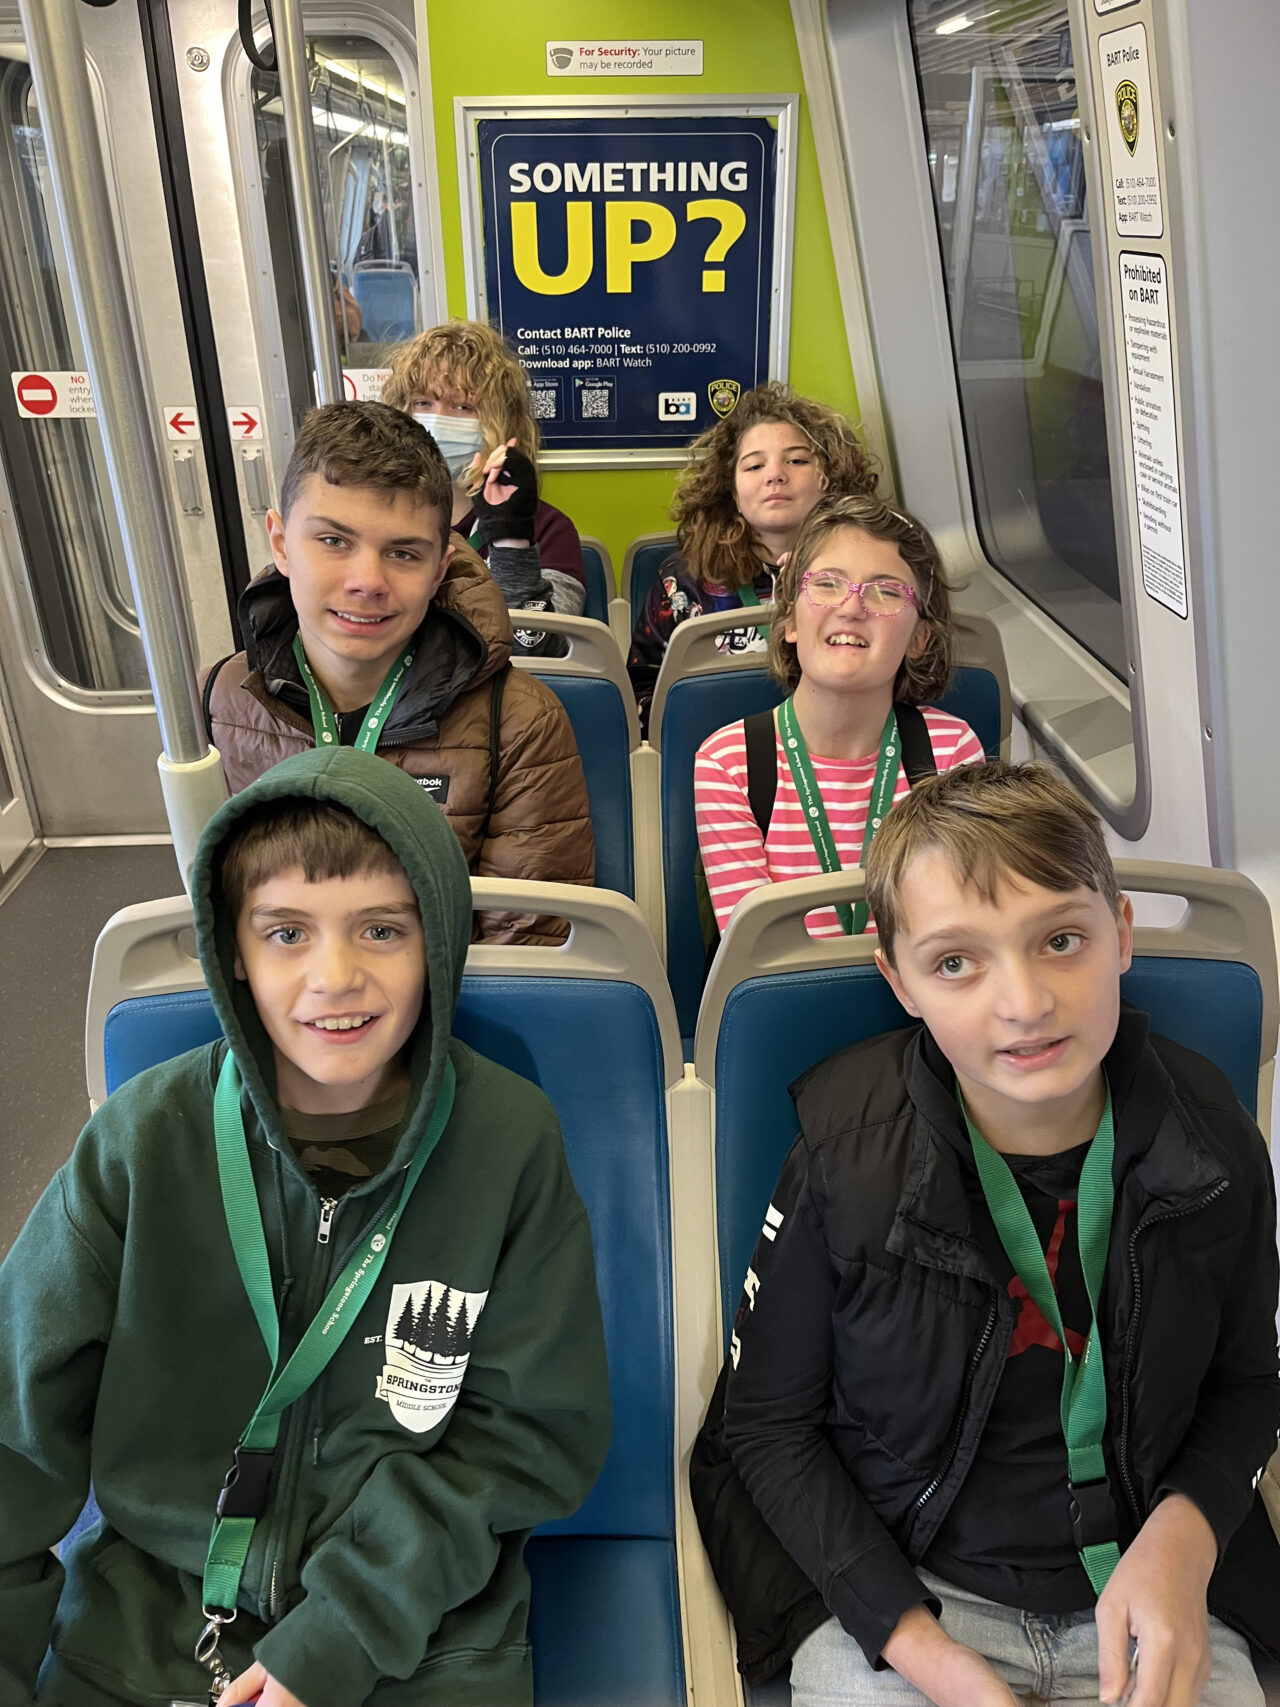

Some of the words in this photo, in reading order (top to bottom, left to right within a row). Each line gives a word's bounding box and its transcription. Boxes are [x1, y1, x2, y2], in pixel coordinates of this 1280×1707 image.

[579, 47, 595, 56] For
[597, 46, 640, 58] Security:
[642, 46, 664, 56] Your
[665, 46, 696, 60] picture
[1107, 50, 1121, 66] BART
[1122, 46, 1139, 63] Police
[579, 61, 598, 71] may
[600, 60, 612, 69] be
[613, 60, 653, 69] recorded
[508, 161, 748, 194] SOMETHING
[510, 198, 747, 295] UP?
[1124, 264, 1161, 284] Prohibited
[1129, 289, 1139, 301] on
[1140, 287, 1159, 305] BART
[517, 328, 561, 339] Contact
[564, 327, 595, 339] BART
[597, 326, 631, 339] Police
[517, 345, 539, 355] Call:
[541, 344, 565, 356] (510)
[567, 344, 613, 354] 464-7000
[620, 344, 644, 354] Text:
[645, 343, 670, 354] (510)
[672, 343, 717, 354] 200-0992
[518, 357, 570, 369] Download
[572, 360, 594, 370] app:
[596, 357, 620, 368] BART
[623, 357, 653, 368] Watch
[71, 375, 85, 384] NO
[362, 374, 375, 382] Do
[69, 386, 91, 396] entry
[711, 381, 738, 392] POLICE
[414, 777, 443, 786] ebok
[361, 1254, 375, 1268] The
[335, 1268, 366, 1312] Springstone
[363, 1334, 383, 1345] EST.
[396, 1400, 422, 1411] MIDDLE
